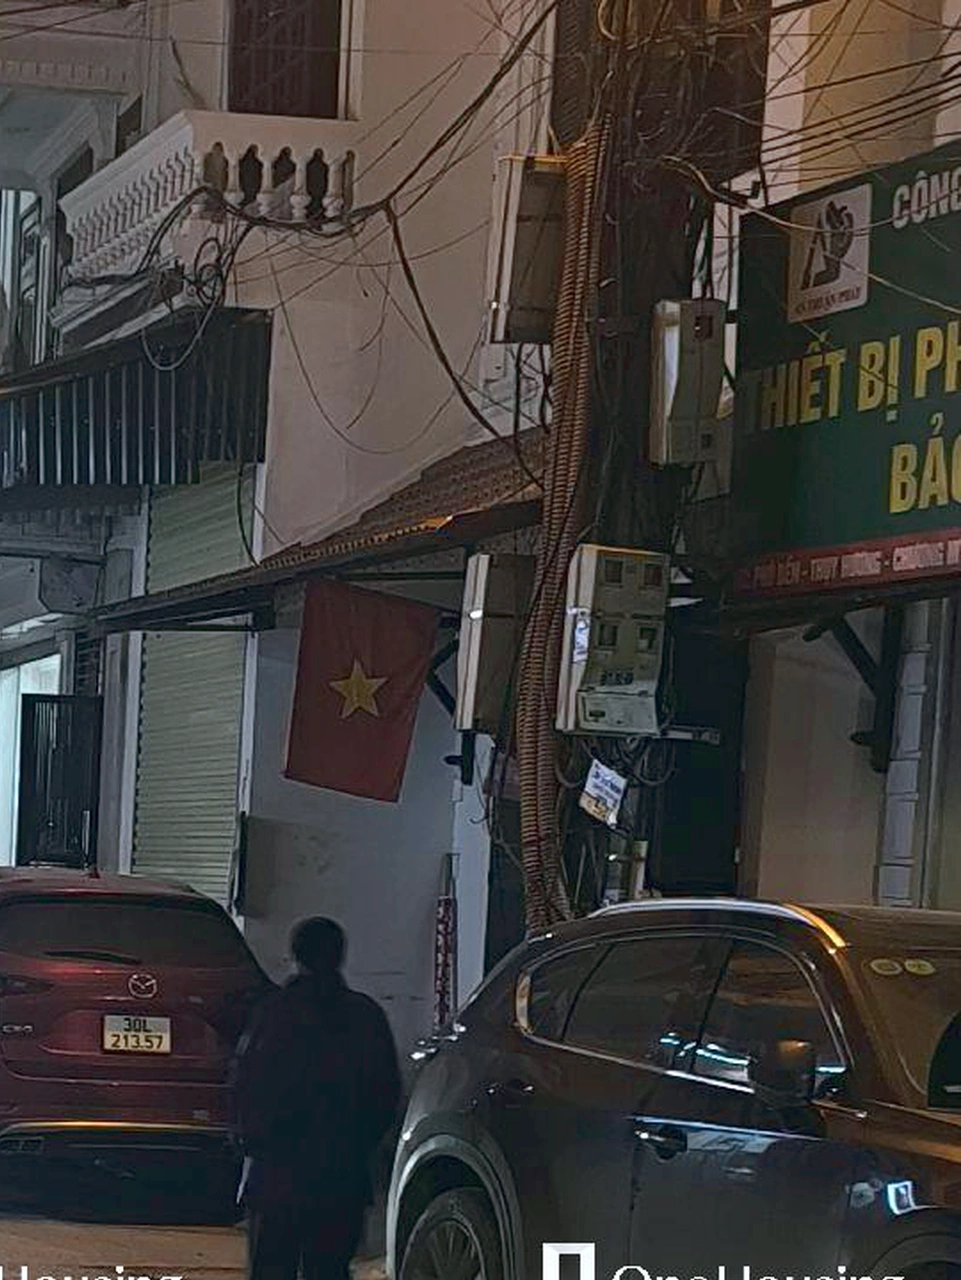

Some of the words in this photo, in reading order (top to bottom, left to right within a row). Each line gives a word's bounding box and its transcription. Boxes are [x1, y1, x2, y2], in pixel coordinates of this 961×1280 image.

[743, 329, 846, 434] THIẾT
[857, 334, 900, 421] BỊ
[123, 1017, 153, 1032] 30L
[111, 1033, 163, 1049] 213.57
